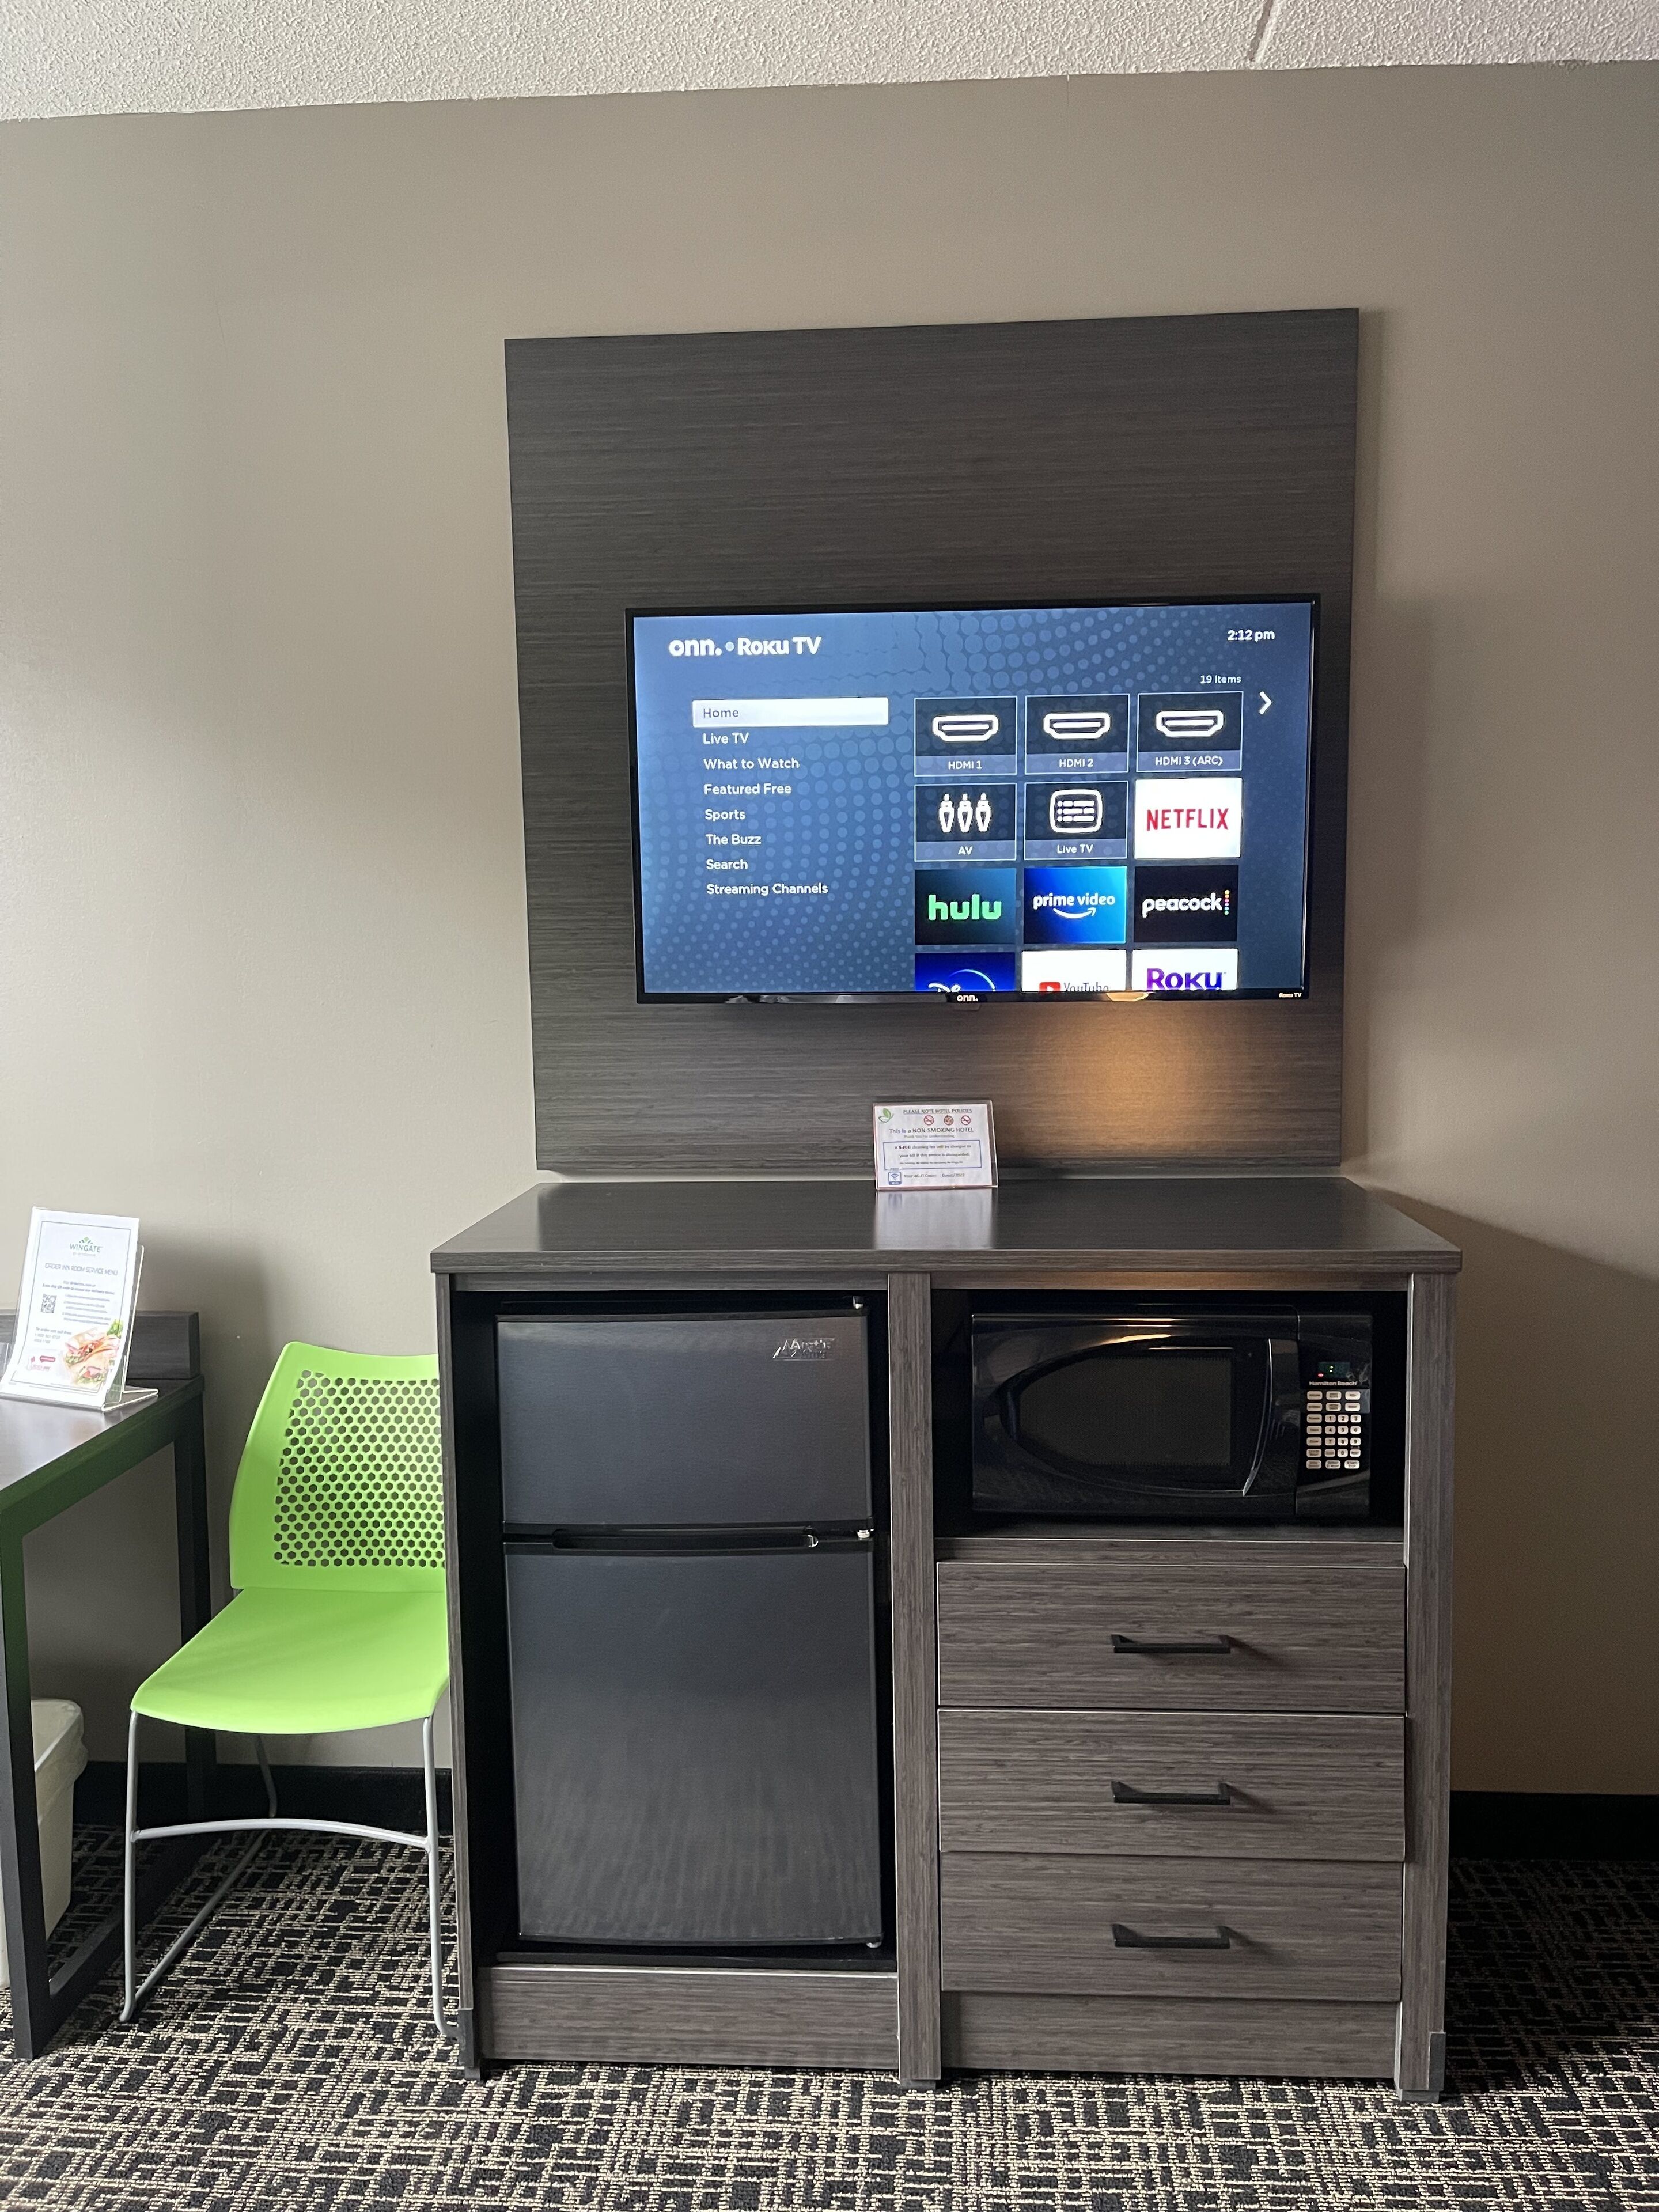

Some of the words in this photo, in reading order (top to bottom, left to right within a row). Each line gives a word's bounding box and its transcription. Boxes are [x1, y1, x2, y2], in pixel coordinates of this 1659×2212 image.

[1227, 630, 1252, 641] 2:12
[1255, 631, 1275, 643] pm
[669, 639, 722, 656] onn.
[737, 638, 789, 656] Roku
[791, 636, 822, 654] TV
[1200, 675, 1213, 684] 19
[1215, 674, 1241, 684] Items
[703, 708, 739, 718] Home
[703, 733, 728, 744] Live
[732, 733, 749, 744] TV
[703, 759, 737, 770] What
[741, 760, 754, 769] to
[757, 758, 800, 769] Watch
[948, 760, 974, 769] HDMI
[976, 760, 982, 768] 1
[1059, 758, 1085, 767] HDMI
[1088, 758, 1094, 767] 2
[1155, 756, 1181, 766] HDMI
[1184, 756, 1191, 765] 3
[1192, 755, 1223, 767] (ARC)
[704, 783, 760, 795] Featured
[763, 783, 791, 794] Free
[705, 809, 745, 822] Sports
[1146, 808, 1229, 831] NETFLIX
[706, 834, 728, 844] The
[732, 834, 761, 844] Buzz
[958, 846, 973, 855] AV
[1056, 844, 1076, 854] Live
[1078, 843, 1093, 854] TV
[706, 859, 748, 870] Search
[706, 884, 768, 896] Streaming
[772, 882, 828, 894] Channels
[1033, 893, 1075, 910] prime
[1077, 892, 1116, 906] video
[1142, 892, 1222, 918] peacock
[928, 894, 1002, 921] hulu
[70, 1244, 101, 1253] WINGATE
[86, 1267, 103, 1275] SERVICE
